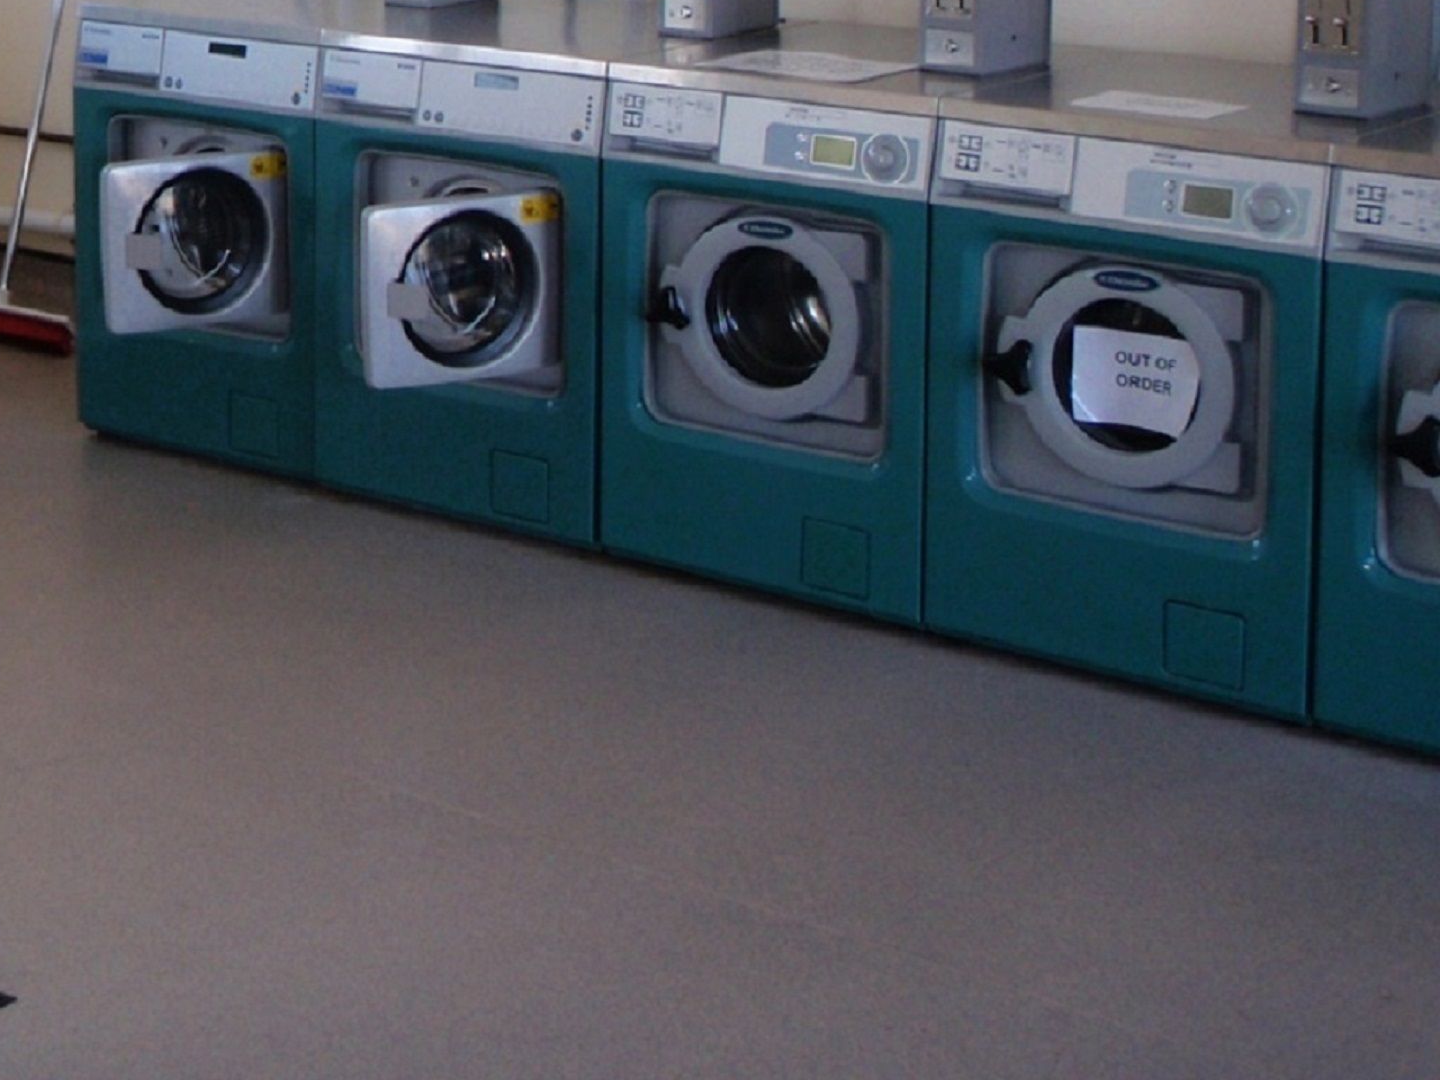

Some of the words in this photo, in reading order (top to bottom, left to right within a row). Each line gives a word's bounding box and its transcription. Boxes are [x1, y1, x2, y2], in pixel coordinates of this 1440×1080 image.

[1114, 350, 1151, 368] OUT
[1154, 357, 1177, 372] OF
[1116, 373, 1172, 396] ORDER
